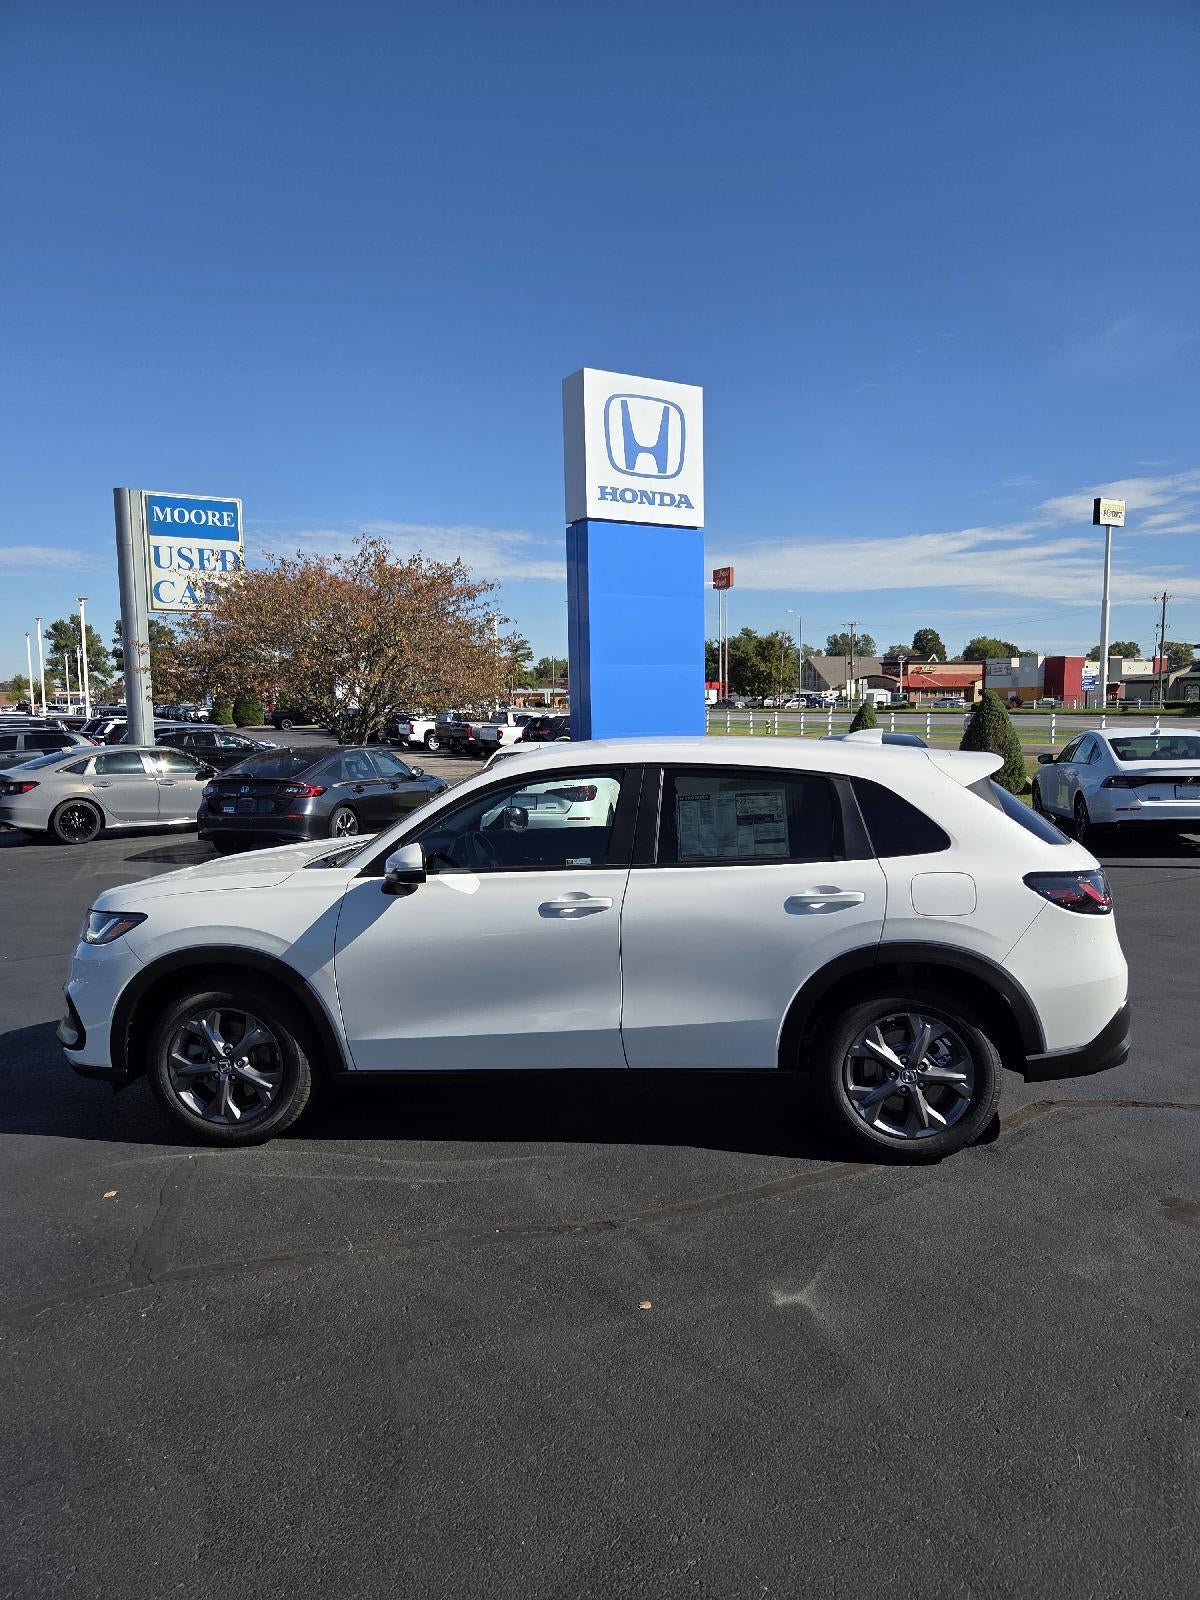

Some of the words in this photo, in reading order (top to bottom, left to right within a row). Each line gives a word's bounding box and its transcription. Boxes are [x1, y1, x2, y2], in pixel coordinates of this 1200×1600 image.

[598, 485, 695, 510] HONDA
[152, 506, 235, 527] MOORE
[153, 545, 241, 571] USED
